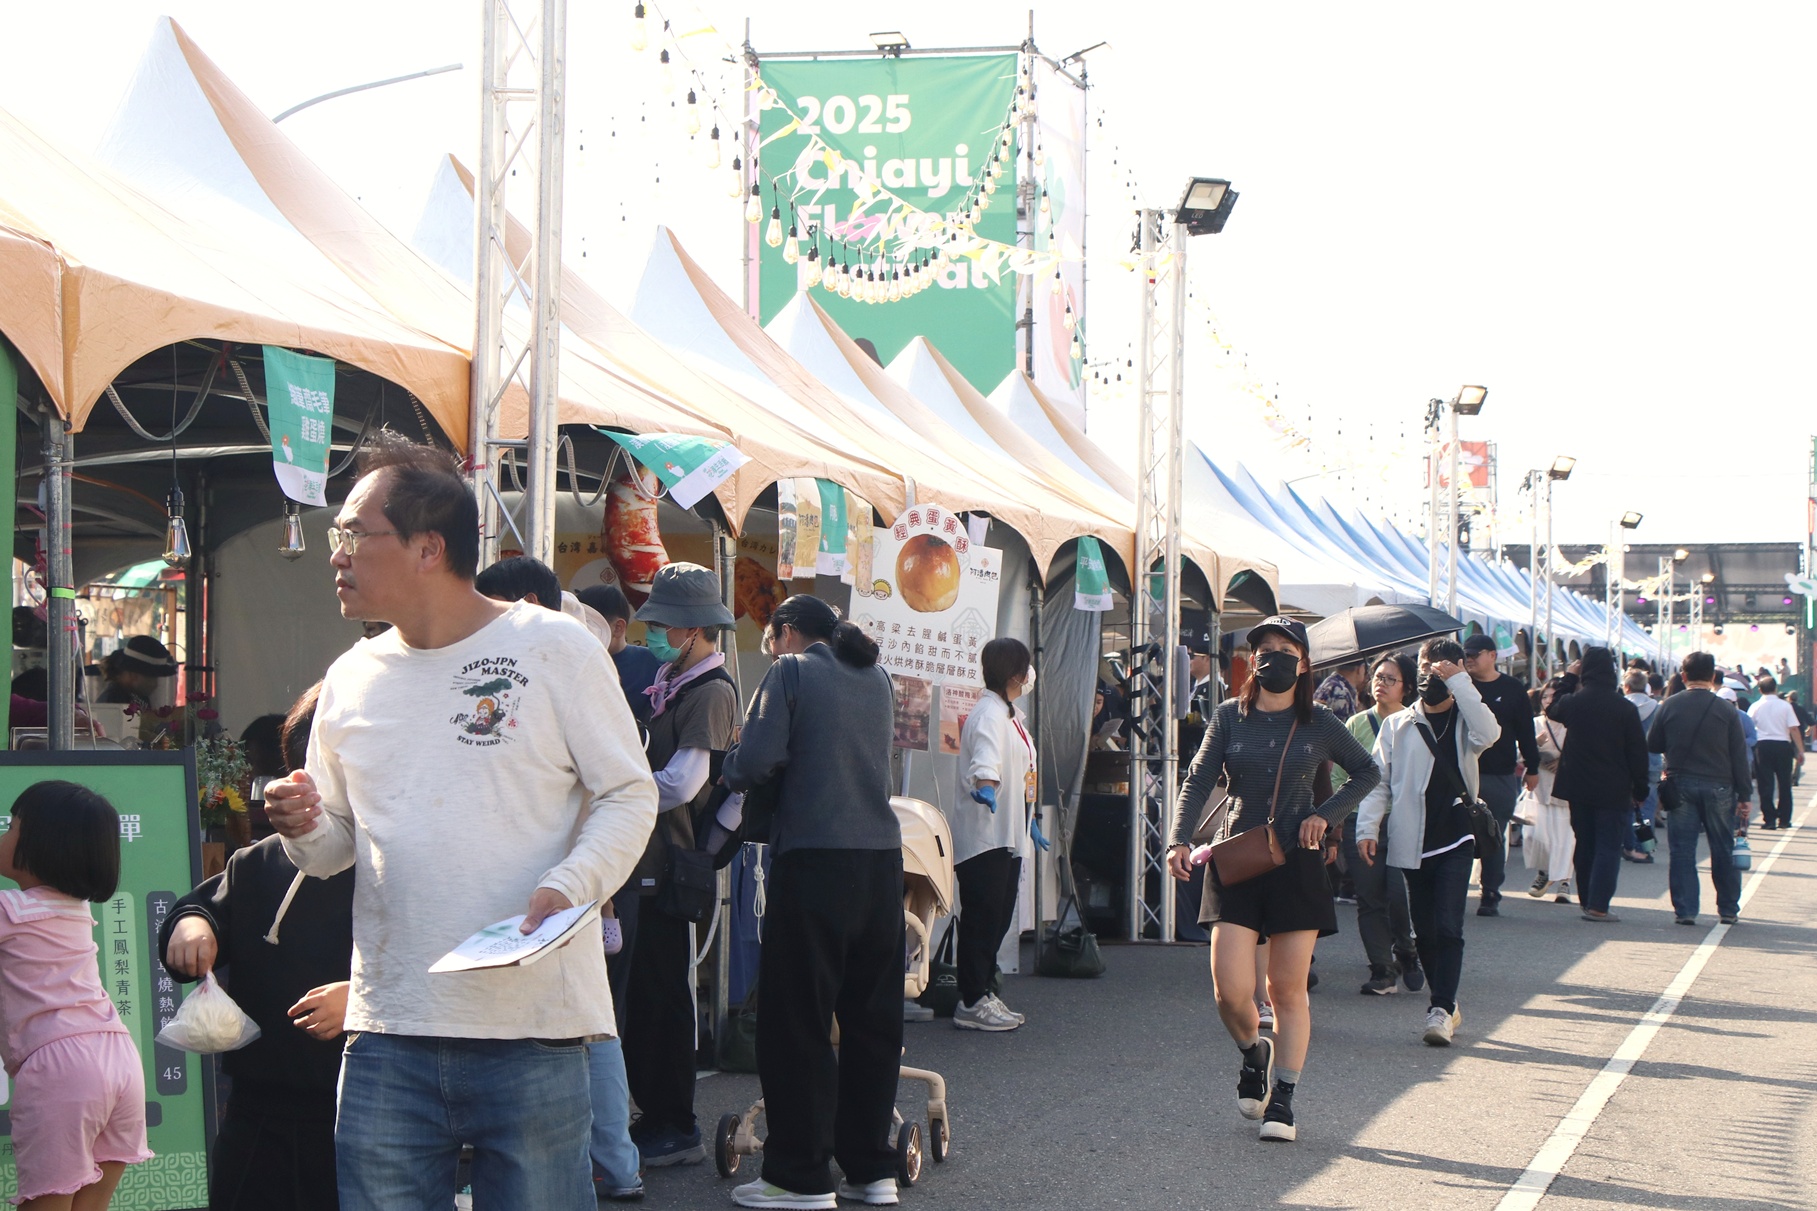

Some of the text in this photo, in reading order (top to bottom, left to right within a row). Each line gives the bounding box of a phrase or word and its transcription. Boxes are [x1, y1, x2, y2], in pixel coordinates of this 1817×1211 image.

[796, 94, 912, 134] 2025
[795, 143, 974, 198] Chiayi
[894, 508, 969, 554] 經典蛋黃酥
[461, 656, 518, 675] JIZO-JPN
[481, 666, 529, 687] MASTER
[456, 735, 474, 746] STAY
[475, 737, 502, 747] WEIRD
[111, 899, 132, 1017] 手工鳳梨青茶
[163, 1066, 182, 1080] 45
